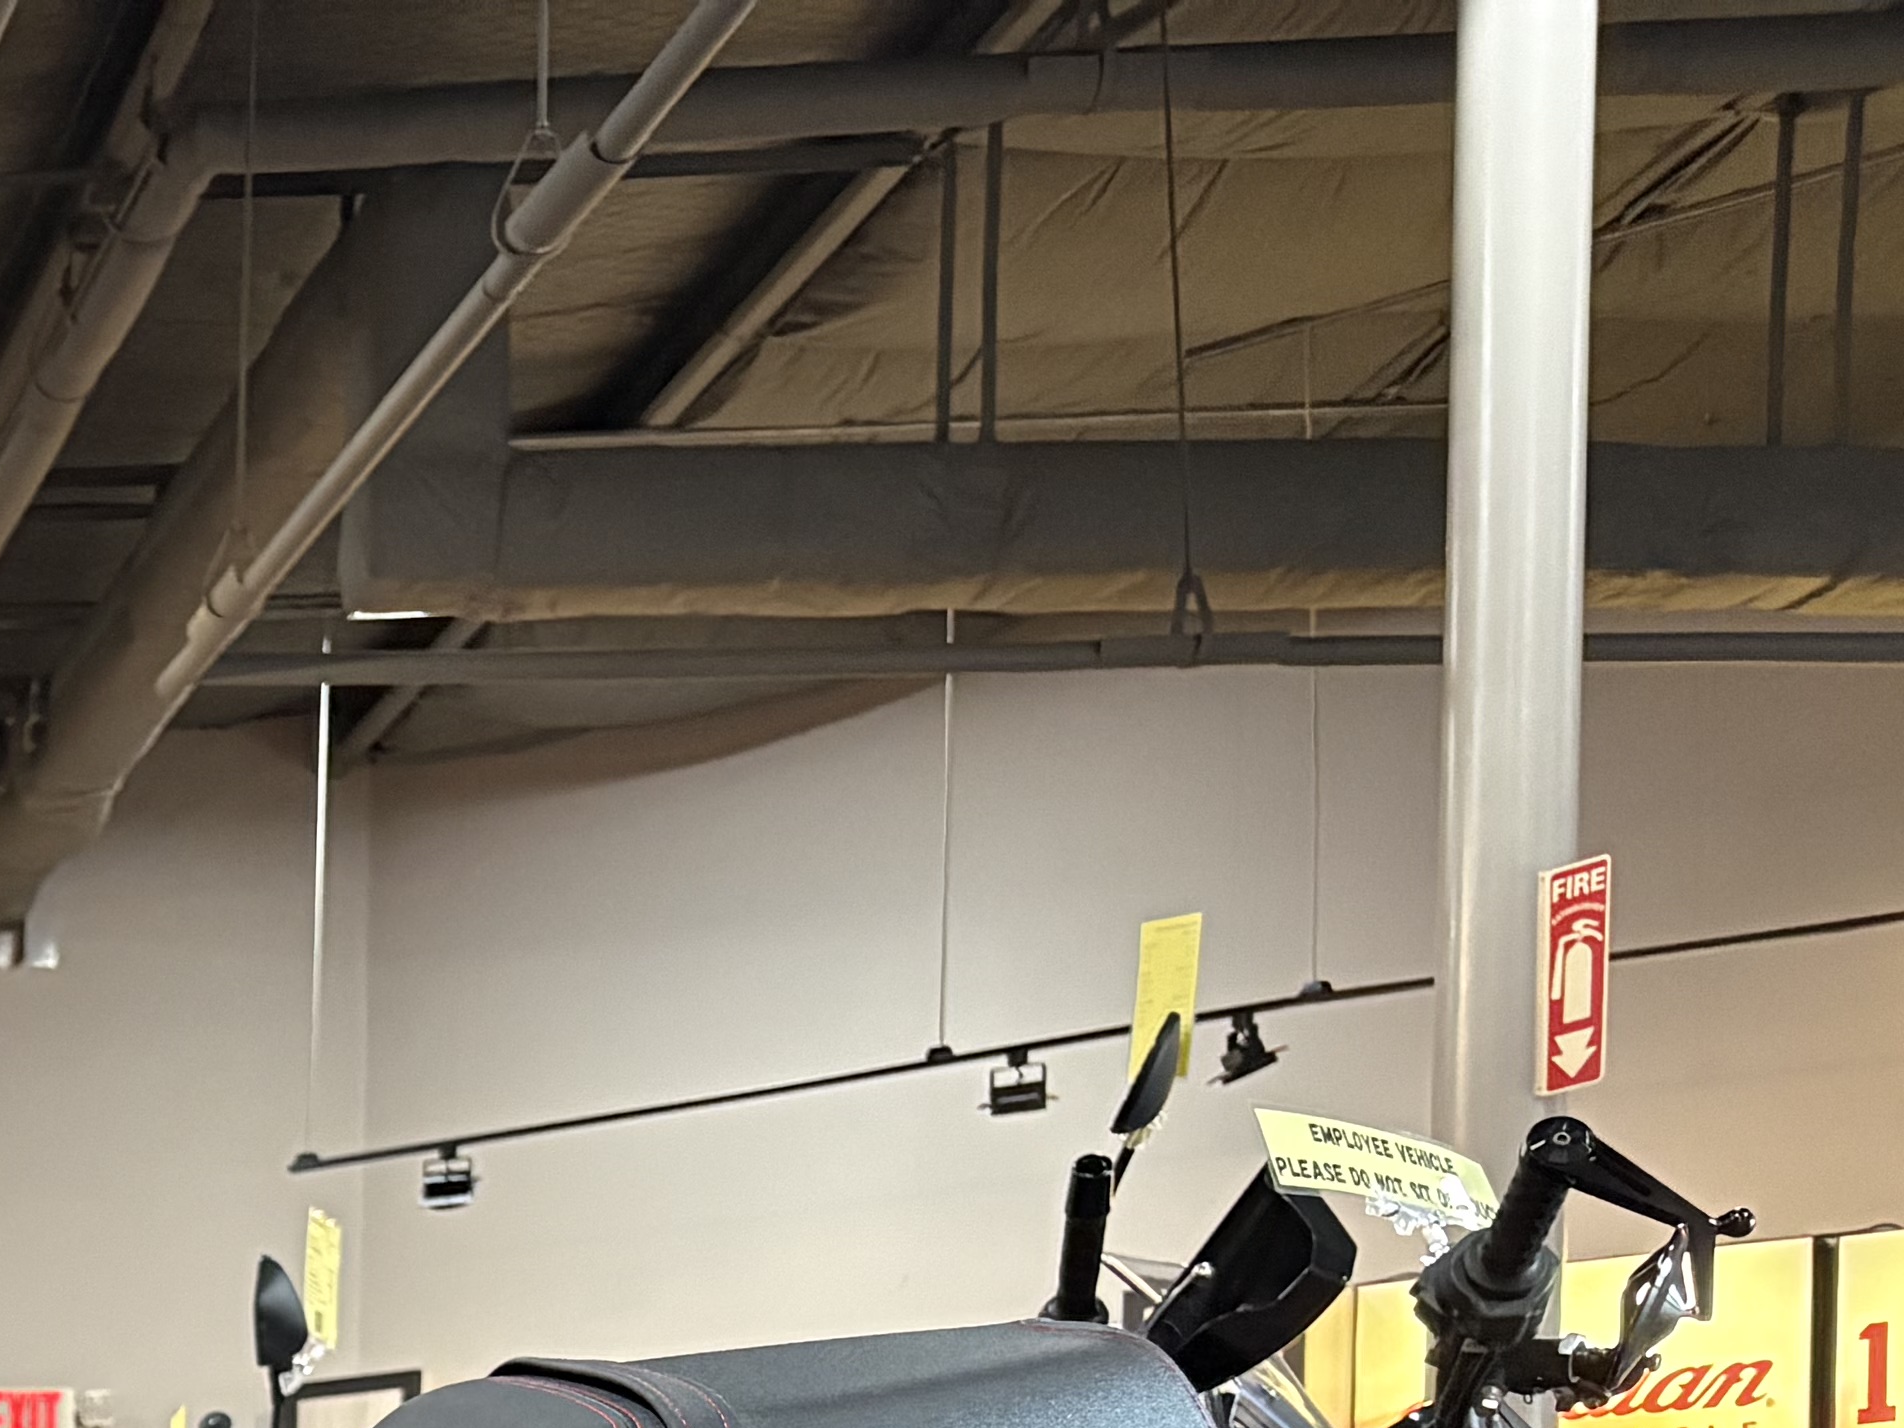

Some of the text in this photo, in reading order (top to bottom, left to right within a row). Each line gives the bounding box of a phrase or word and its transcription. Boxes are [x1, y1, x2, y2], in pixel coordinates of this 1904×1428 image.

[1553, 866, 1607, 903] FIRE
[1308, 1122, 1455, 1172] EMPLOYEE VEHICLE
[1275, 1156, 1346, 1184] PLEASE
[1348, 1167, 1371, 1188] DO
